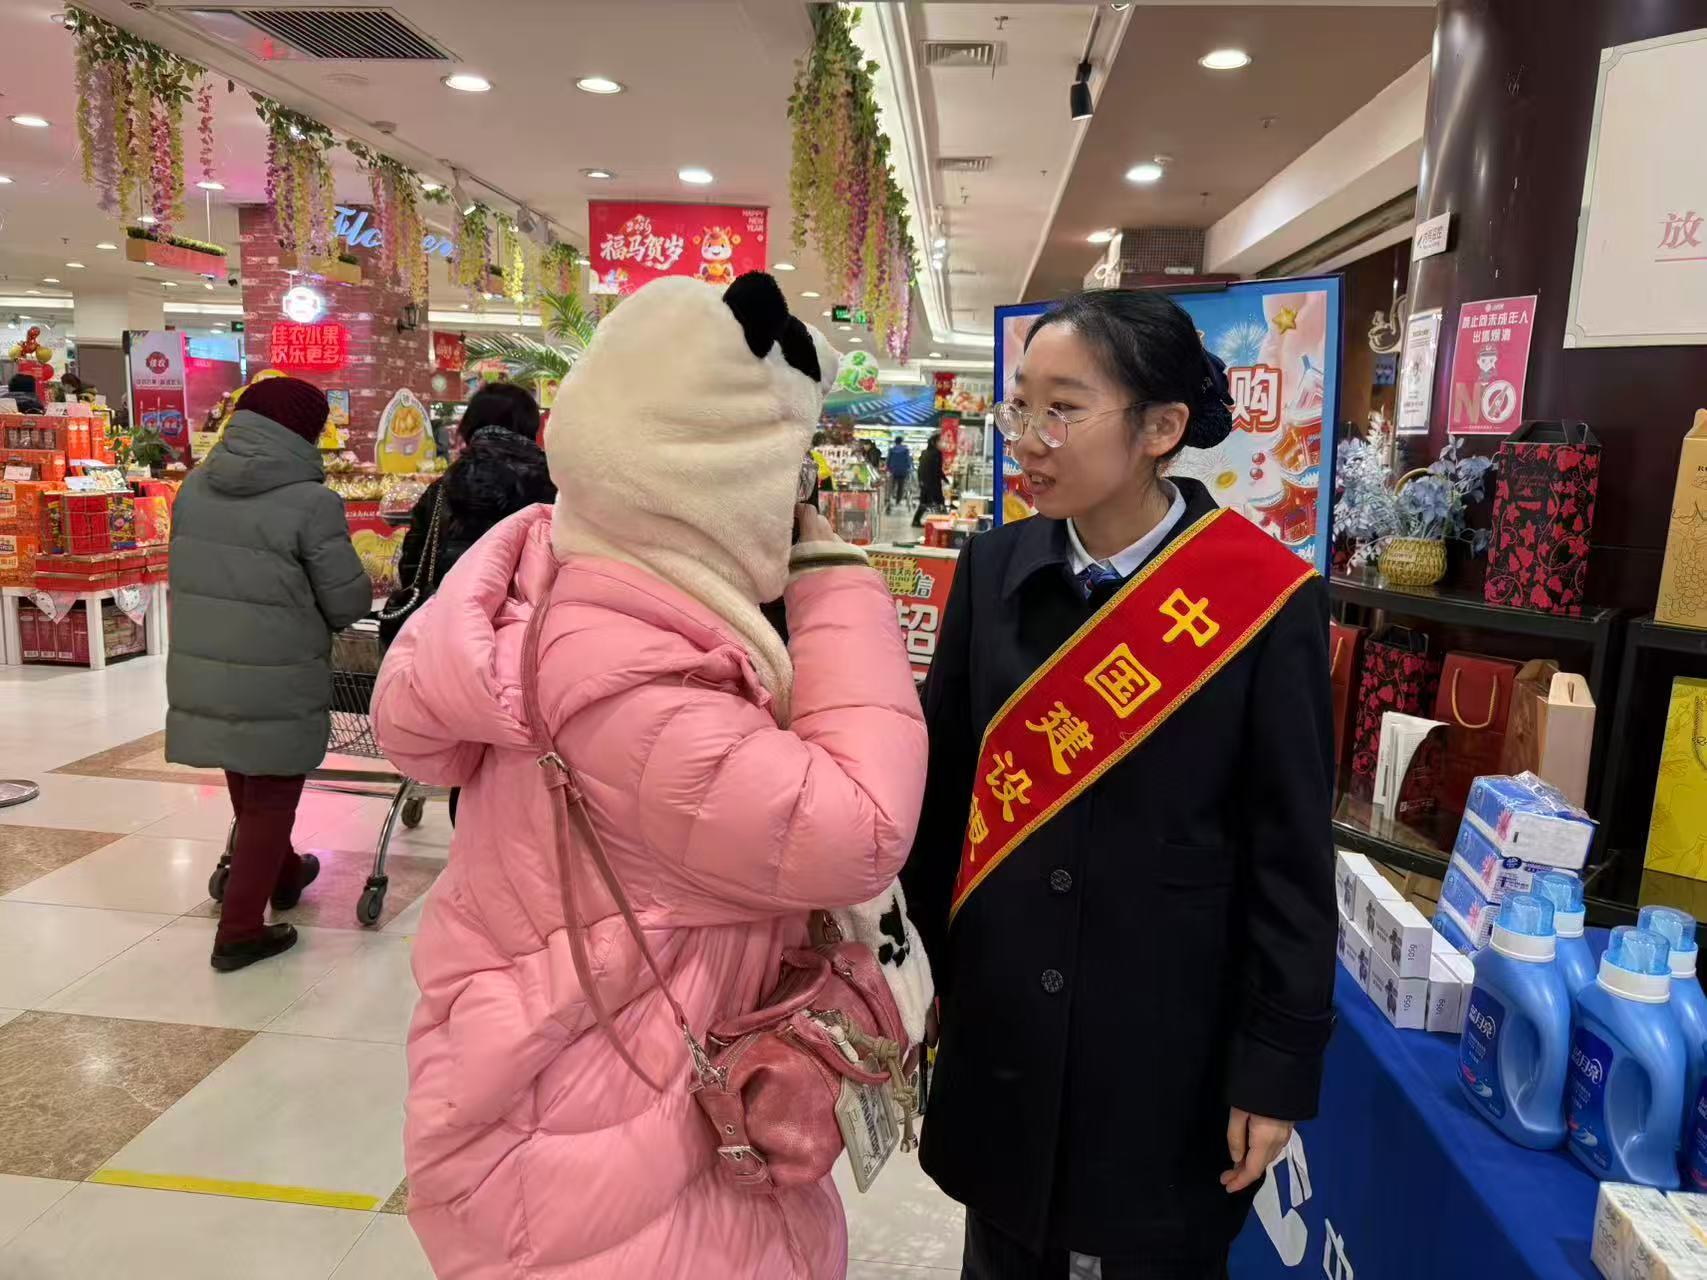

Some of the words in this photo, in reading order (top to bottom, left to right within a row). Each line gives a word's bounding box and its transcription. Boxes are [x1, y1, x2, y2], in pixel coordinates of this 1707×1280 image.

[746, 224, 764, 233] YEAR
[748, 217, 764, 226] NEW
[1656, 210, 1705, 249] 放
[600, 233, 685, 265] 福马贺岁
[271, 325, 339, 345] 佳农水果
